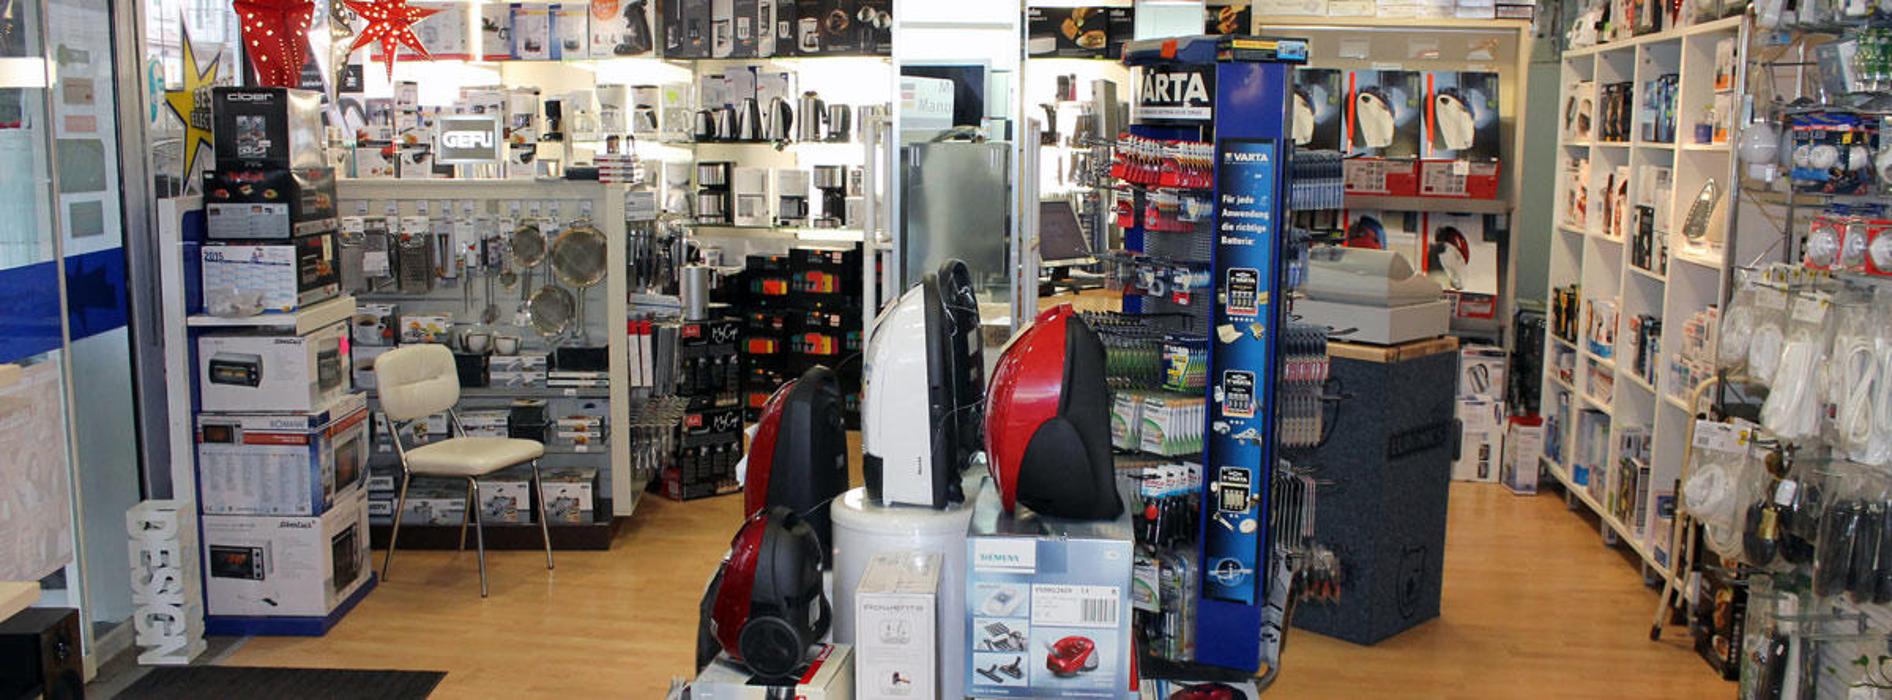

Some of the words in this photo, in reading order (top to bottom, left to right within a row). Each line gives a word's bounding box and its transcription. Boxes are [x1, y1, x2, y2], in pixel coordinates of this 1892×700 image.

[443, 130, 494, 149] GEFU
[1234, 152, 1268, 162] VARTA
[1222, 194, 1236, 203] Für
[1236, 195, 1254, 206] jede
[1221, 208, 1269, 220] Anwendung
[1221, 222, 1234, 232] die
[1235, 223, 1267, 234] richtige
[979, 553, 1020, 562] SIEMENS
[126, 510, 189, 665] DESIGN
